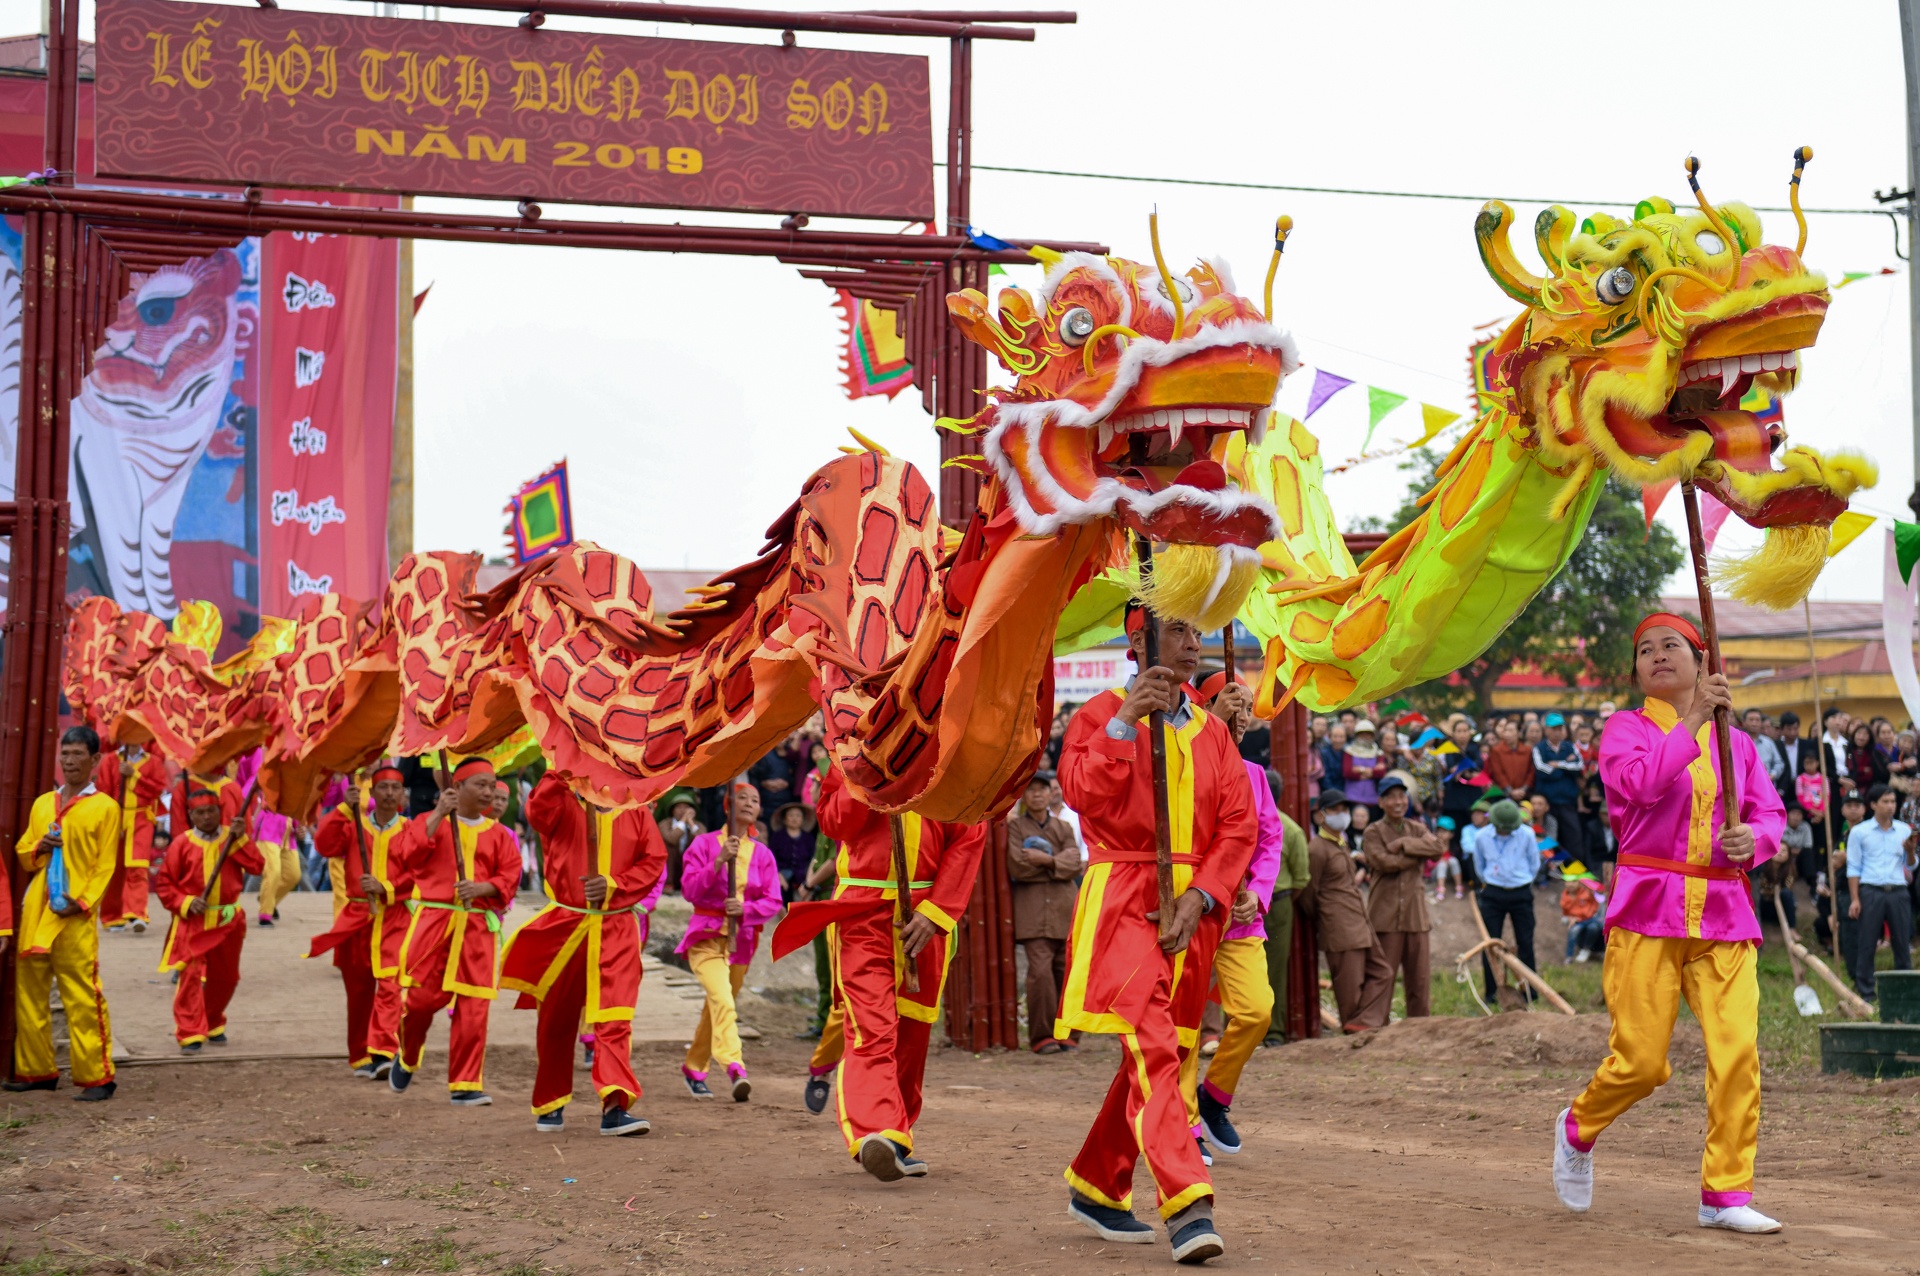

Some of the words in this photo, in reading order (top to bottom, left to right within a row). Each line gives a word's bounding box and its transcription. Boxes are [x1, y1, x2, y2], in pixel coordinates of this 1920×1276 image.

[146, 17, 222, 90] LỄ
[237, 29, 339, 108] HỘI
[359, 48, 491, 119] TỊCH
[786, 76, 892, 135] SƠN
[355, 123, 527, 164] NĂM
[552, 141, 704, 175] 2019
[290, 417, 327, 455] Hội
